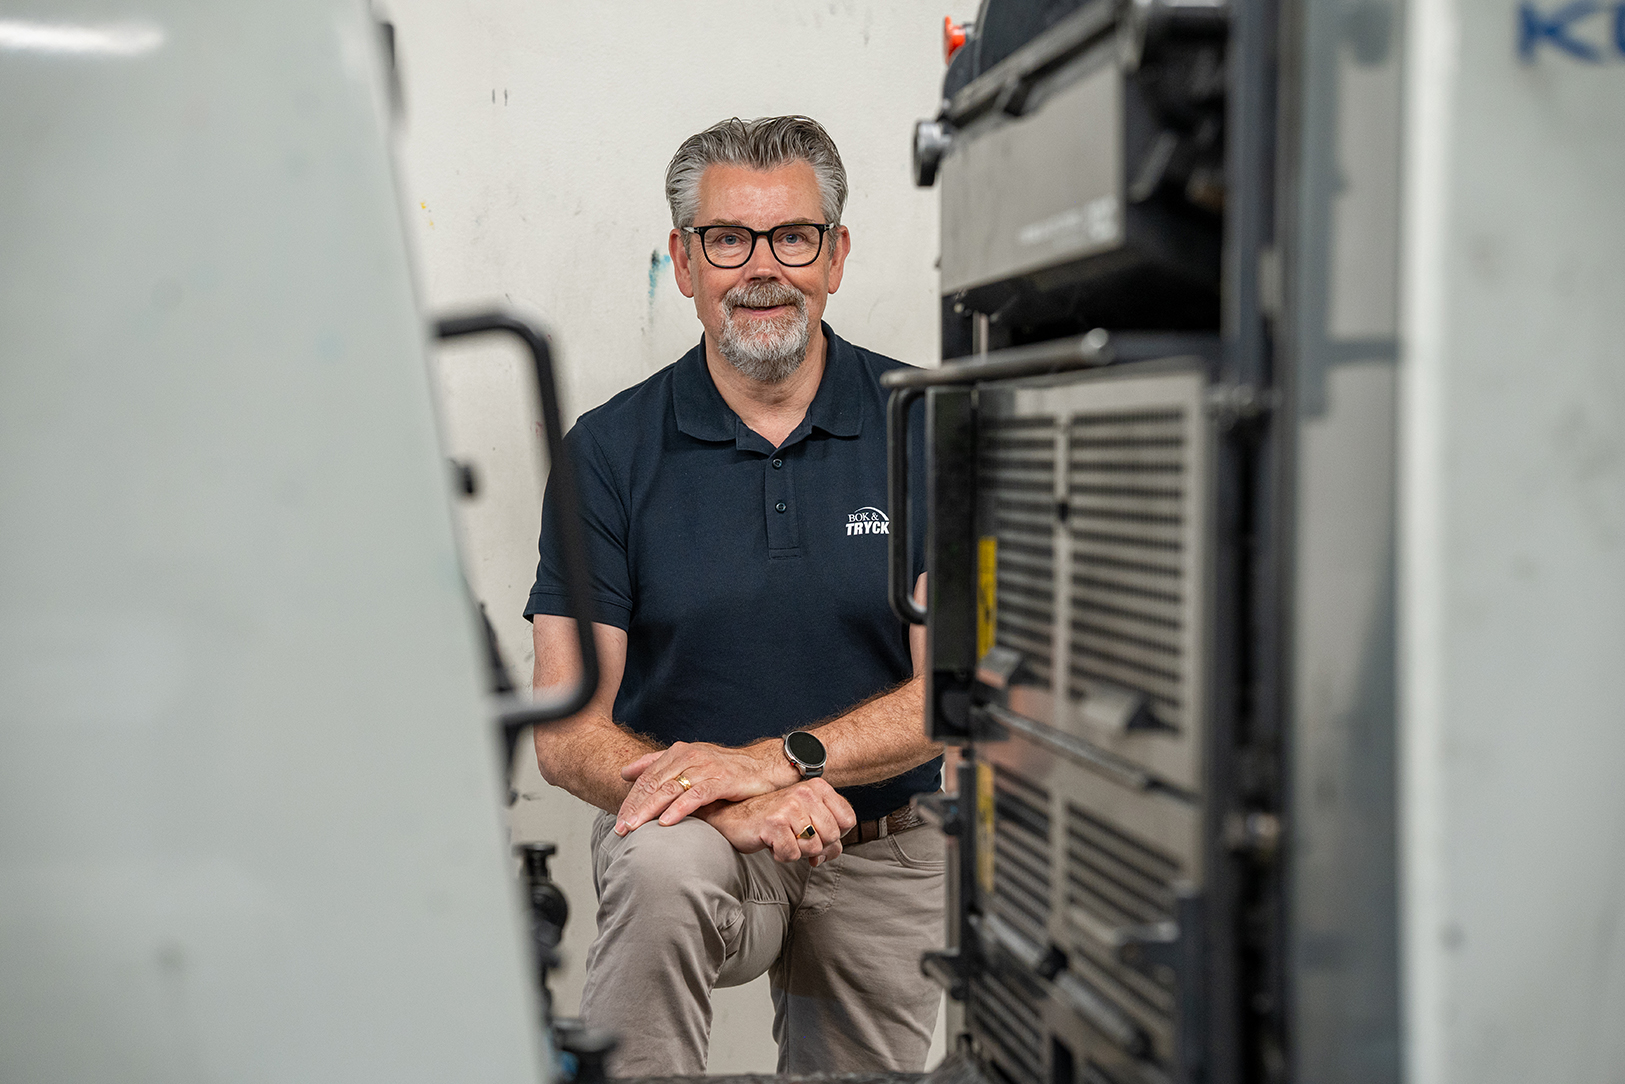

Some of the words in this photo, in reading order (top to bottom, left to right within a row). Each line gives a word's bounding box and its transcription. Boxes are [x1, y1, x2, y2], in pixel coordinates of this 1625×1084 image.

[1516, 0, 1625, 65] K
[848, 512, 870, 522] BOK
[871, 512, 879, 521] &
[846, 521, 889, 536] TRYCK
